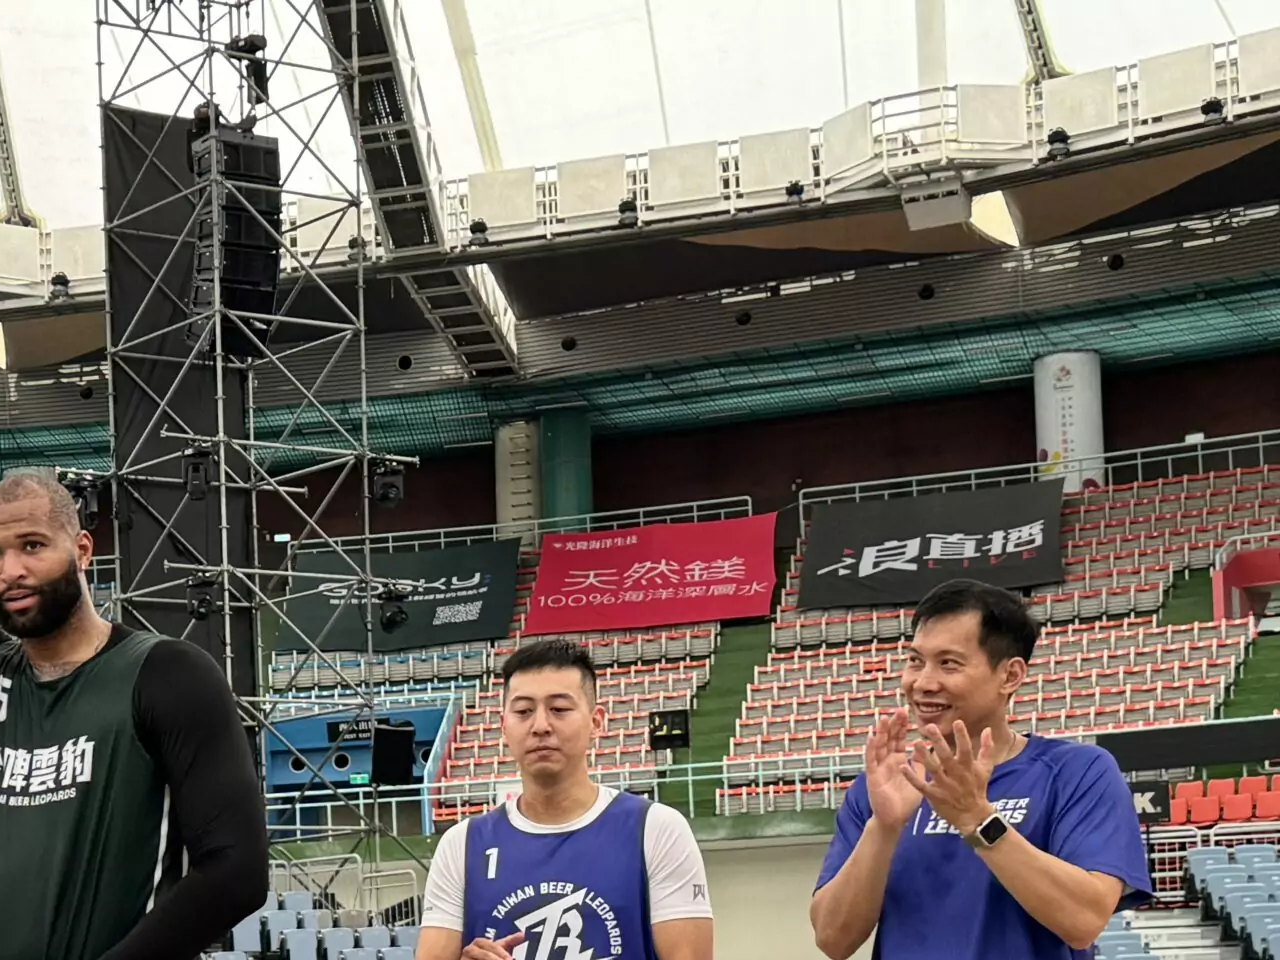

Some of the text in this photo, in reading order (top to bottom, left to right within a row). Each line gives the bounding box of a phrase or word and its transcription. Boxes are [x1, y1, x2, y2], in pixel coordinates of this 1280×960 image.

[561, 556, 747, 591] 天然鎂
[30, 787, 77, 806] LEOPARDS
[485, 847, 499, 879] 1
[492, 885, 535, 919] TAIWAN
[540, 882, 574, 895] BEER
[585, 891, 623, 955] LEOPARDS
